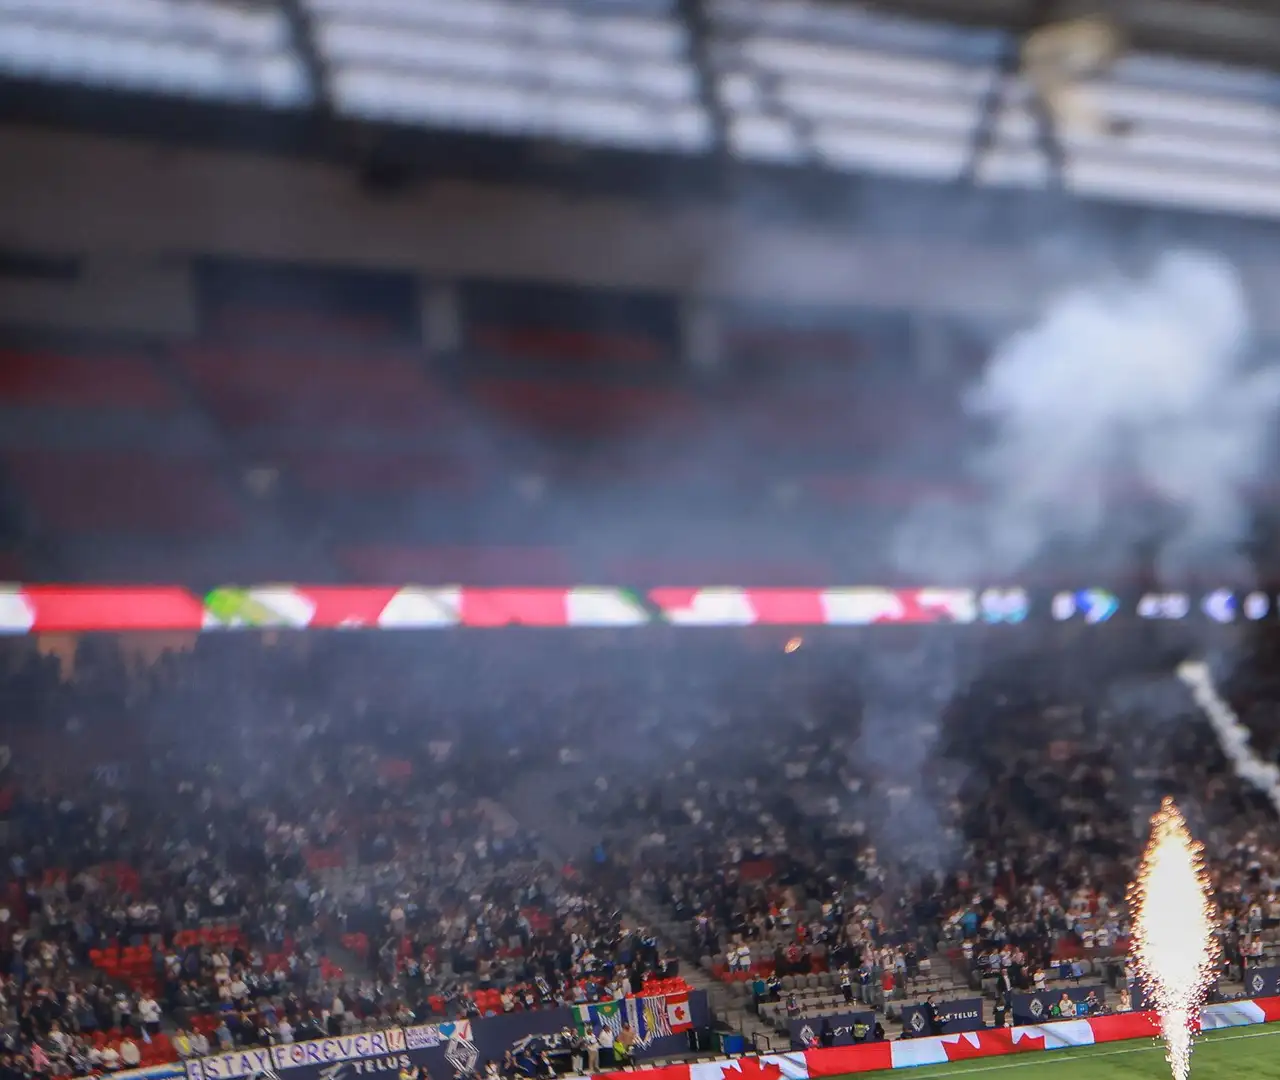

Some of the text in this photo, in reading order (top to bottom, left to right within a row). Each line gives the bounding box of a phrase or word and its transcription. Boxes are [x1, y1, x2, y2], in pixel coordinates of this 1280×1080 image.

[953, 1009, 979, 1021] TELUS
[206, 1050, 270, 1077] STAY
[274, 1033, 385, 1069] FOREVER
[352, 1054, 412, 1075] TELUS
